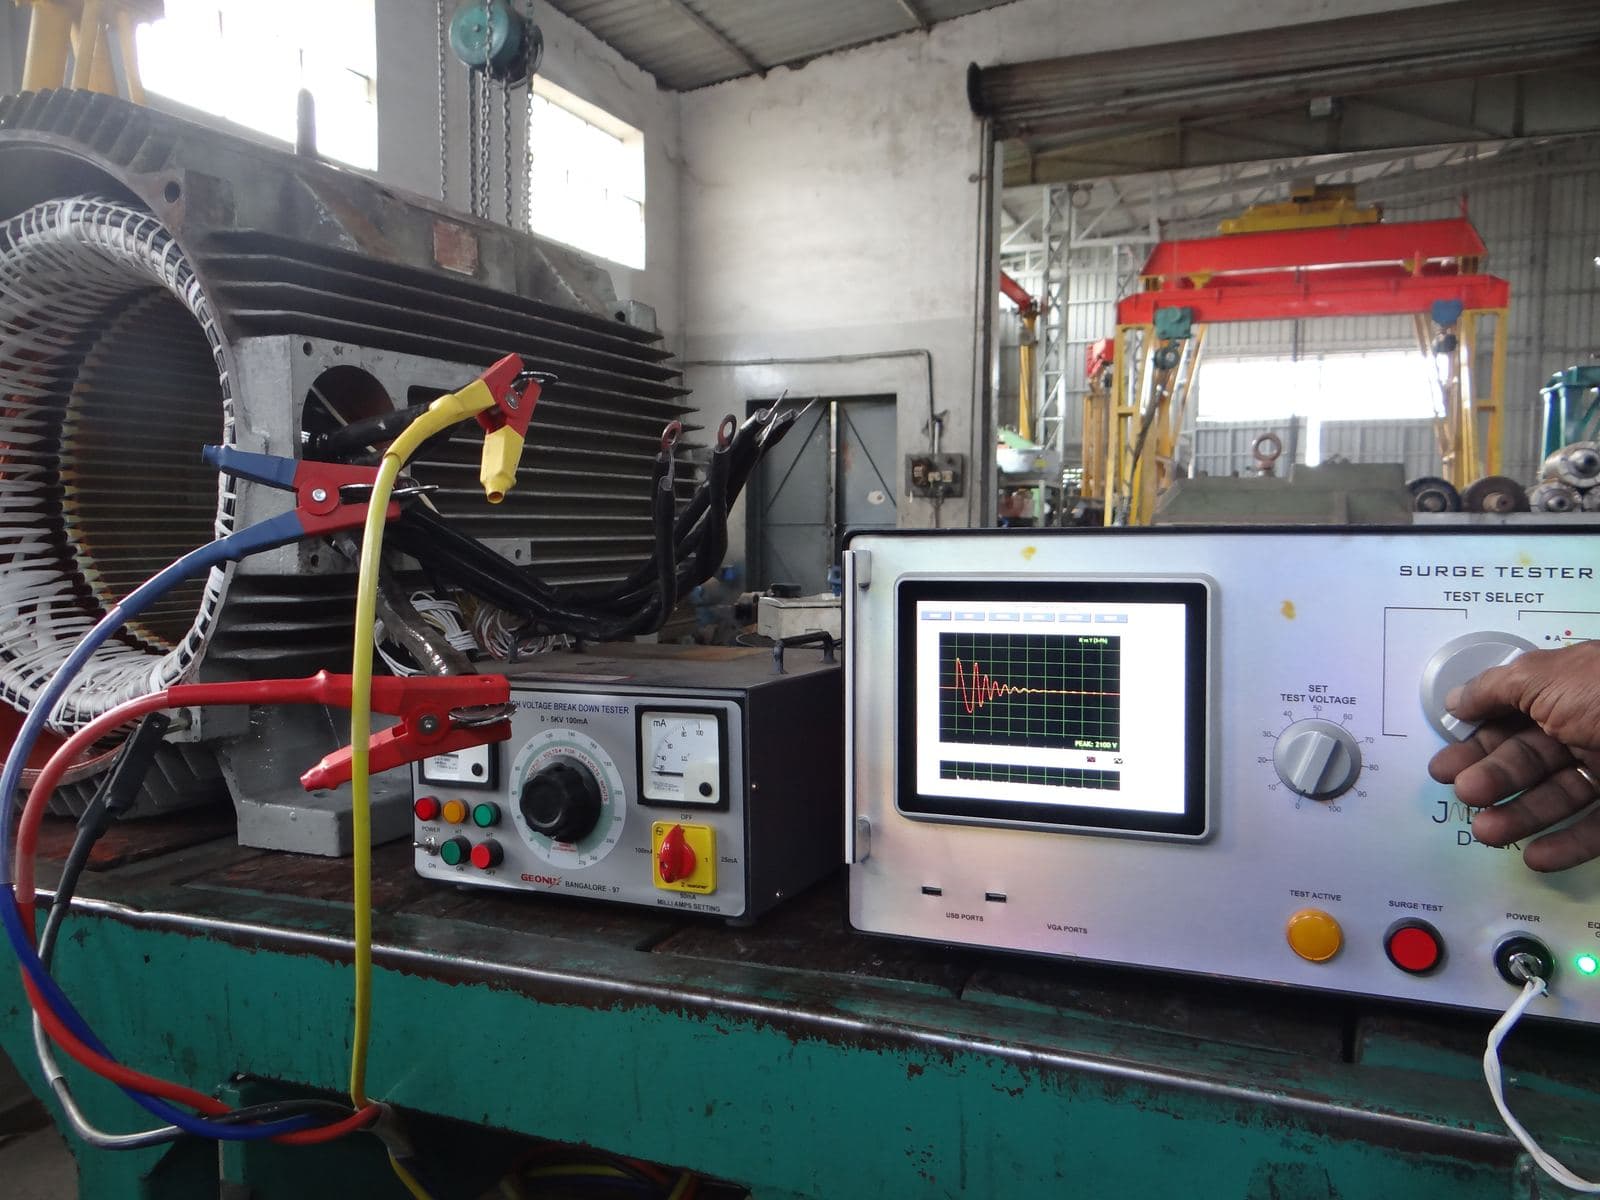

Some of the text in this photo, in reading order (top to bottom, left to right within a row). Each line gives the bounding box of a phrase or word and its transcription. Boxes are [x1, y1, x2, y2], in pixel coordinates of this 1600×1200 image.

[1399, 565, 1594, 579] SURGE TESTER
[1443, 591, 1545, 604] TEST SELECT
[1308, 684, 1328, 693] SET
[1280, 693, 1357, 705] TEST VOLTAGE
[522, 701, 553, 711] VOLTAGE
[554, 702, 577, 712] BREAK
[578, 703, 600, 714] DOWN
[601, 705, 630, 715] TESTER
[551, 716, 564, 724] 5KV
[566, 717, 589, 725] 100mA
[653, 718, 667, 728] mA
[1262, 730, 1272, 738] 30
[1364, 736, 1375, 744] 70
[1357, 790, 1368, 798] 90
[1328, 805, 1342, 813] 100
[422, 825, 441, 833] POWER
[720, 856, 738, 864] 25mA
[565, 880, 607, 892] BANGALORE
[612, 886, 620, 894] 97
[1289, 890, 1342, 901] TEST ACTIVE
[674, 901, 693, 910] AMPS
[693, 904, 720, 912] SETTING
[1388, 900, 1444, 912] SURGE TEST
[960, 914, 984, 922] PORTS
[1506, 912, 1541, 923] POWER
[1047, 923, 1088, 935] VGA PORTS
